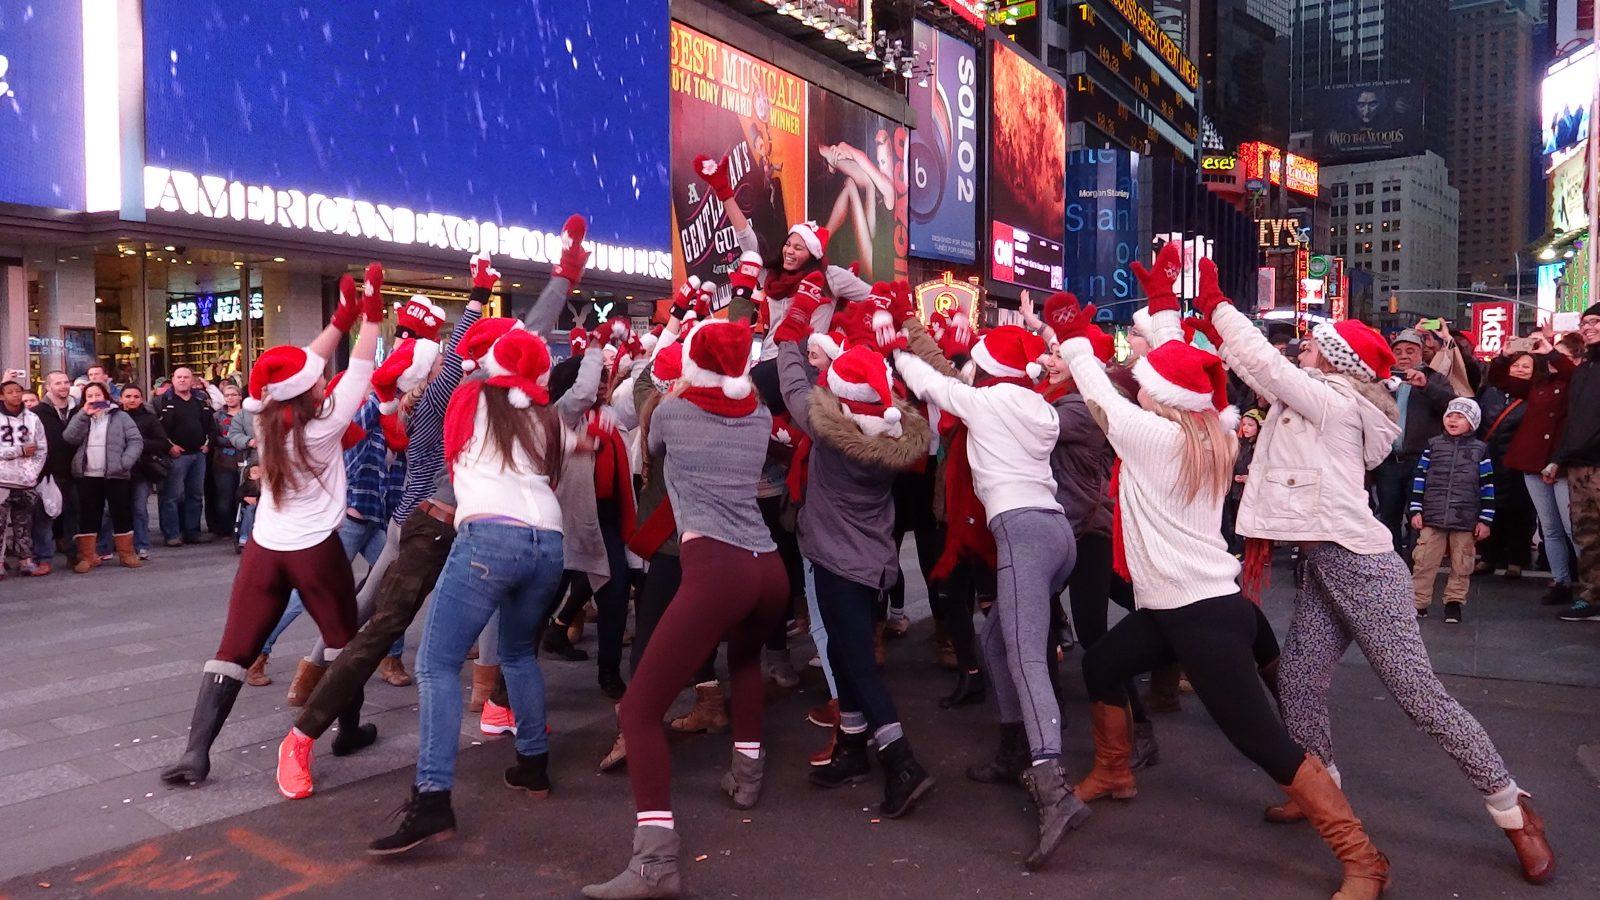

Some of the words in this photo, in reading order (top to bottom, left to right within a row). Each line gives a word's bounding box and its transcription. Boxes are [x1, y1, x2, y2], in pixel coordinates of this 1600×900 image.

[671, 67, 691, 95] 014
[693, 76, 719, 106] TONY
[721, 86, 752, 118] AWARD
[770, 106, 800, 136] WINNER
[957, 55, 975, 173] SOLO
[1365, 127, 1404, 144] WOODS
[1202, 156, 1236, 170] ese's
[688, 182, 700, 205] A
[957, 175, 974, 203] 2
[1078, 189, 1106, 199] Morgan
[1106, 188, 1130, 200] Stanley
[144, 165, 415, 244] AMERICAN
[1258, 218, 1300, 247] EY'S
[1481, 306, 1508, 352] tkts
